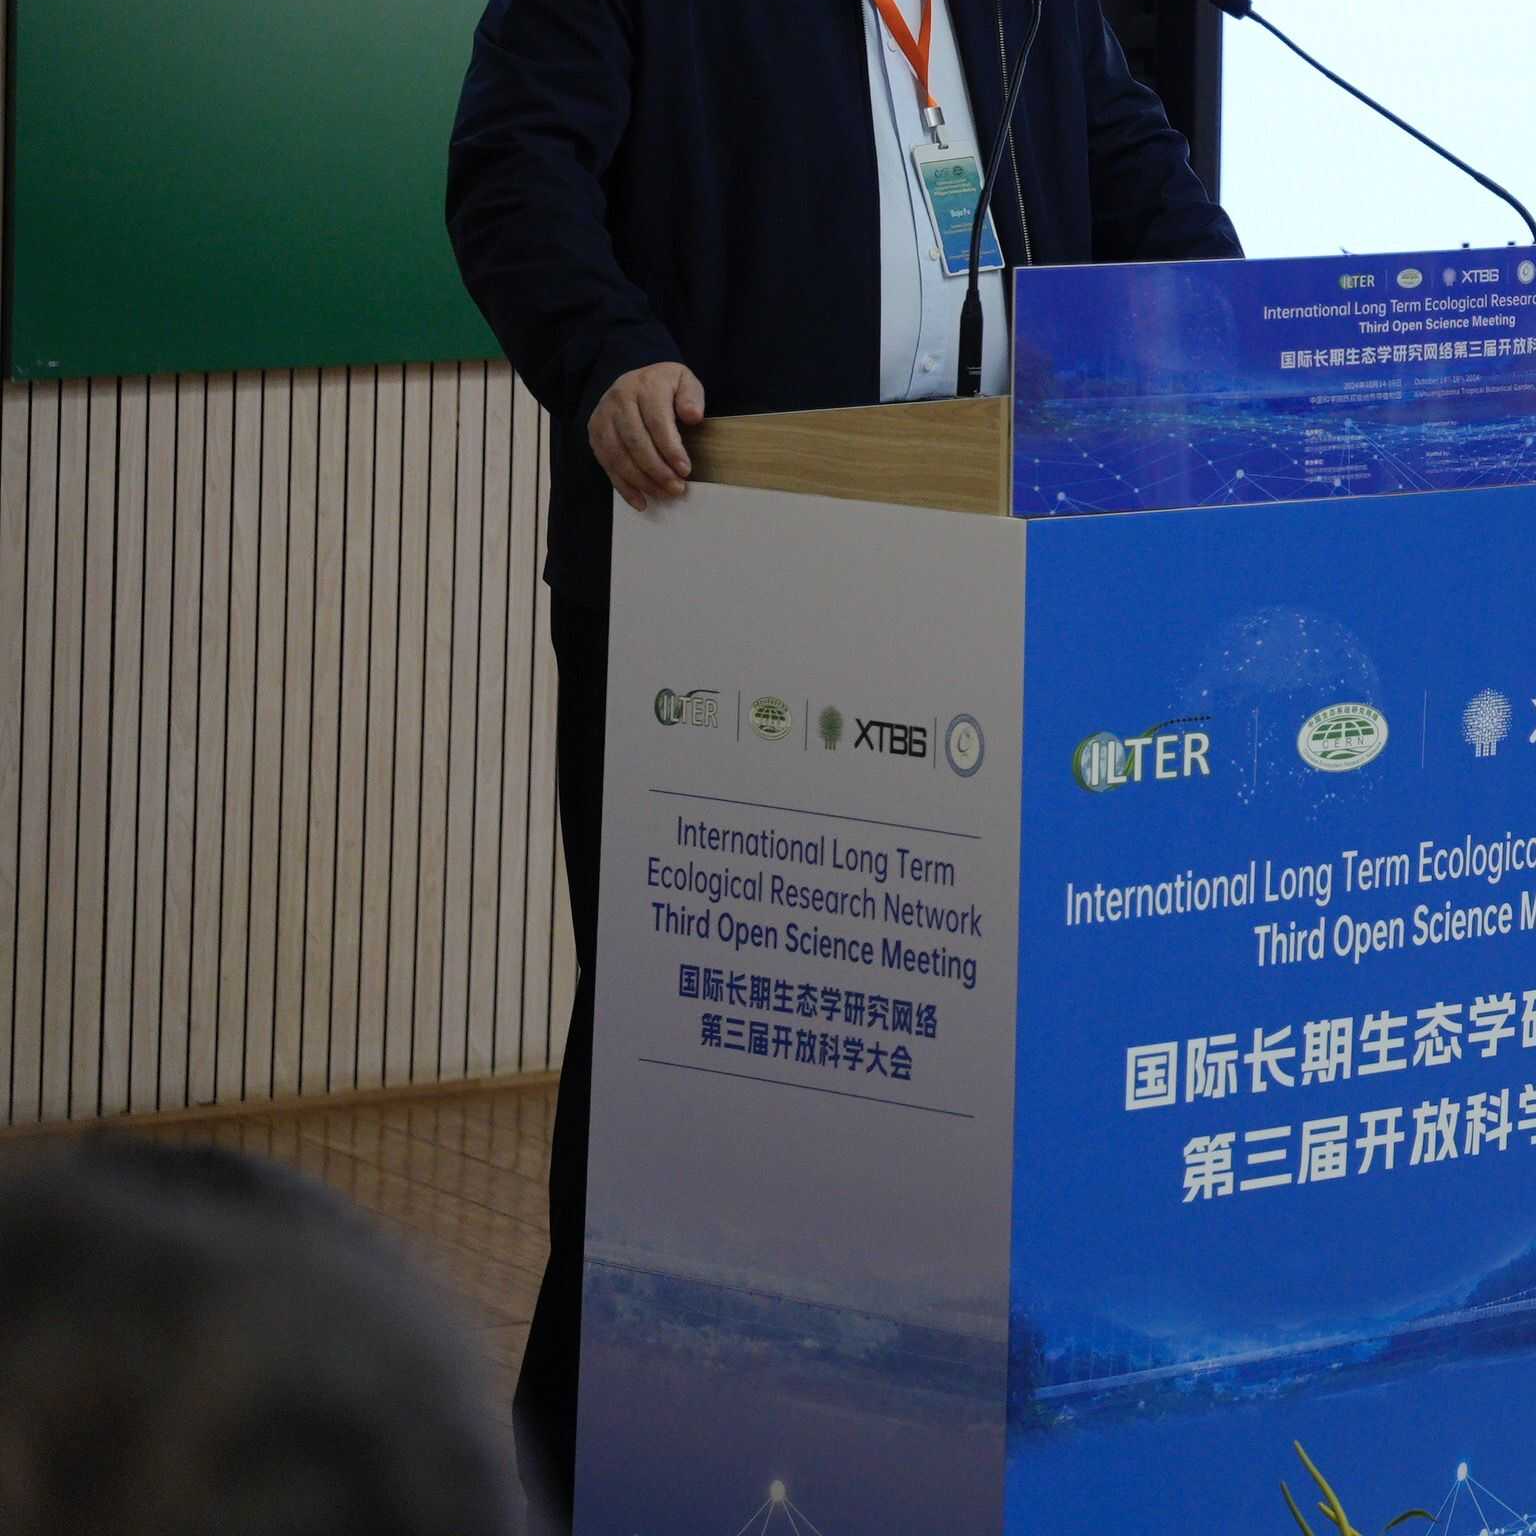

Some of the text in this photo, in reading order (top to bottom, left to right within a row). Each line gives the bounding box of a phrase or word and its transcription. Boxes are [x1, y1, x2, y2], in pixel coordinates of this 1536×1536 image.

[1264, 302, 1350, 319] International
[1355, 302, 1386, 317] Long
[1390, 300, 1421, 312] Term
[1424, 295, 1488, 312] Ecological
[1359, 312, 1517, 334] Third Open Science Meeting
[1091, 732, 1211, 786] ILTER
[678, 816, 954, 886] International Long Term
[648, 857, 981, 936] Ecological Research Network
[1067, 861, 1255, 925] International
[1265, 861, 1332, 906] Long
[1342, 850, 1409, 891] Term
[652, 902, 976, 988] Third Open Science Meeting
[1254, 917, 1325, 966] Third
[1334, 915, 1404, 964] Open
[1413, 901, 1512, 945] Science
[678, 963, 939, 1040] 国际长期生态学研究网络
[700, 1012, 913, 1081] 第三届开放科学大会
